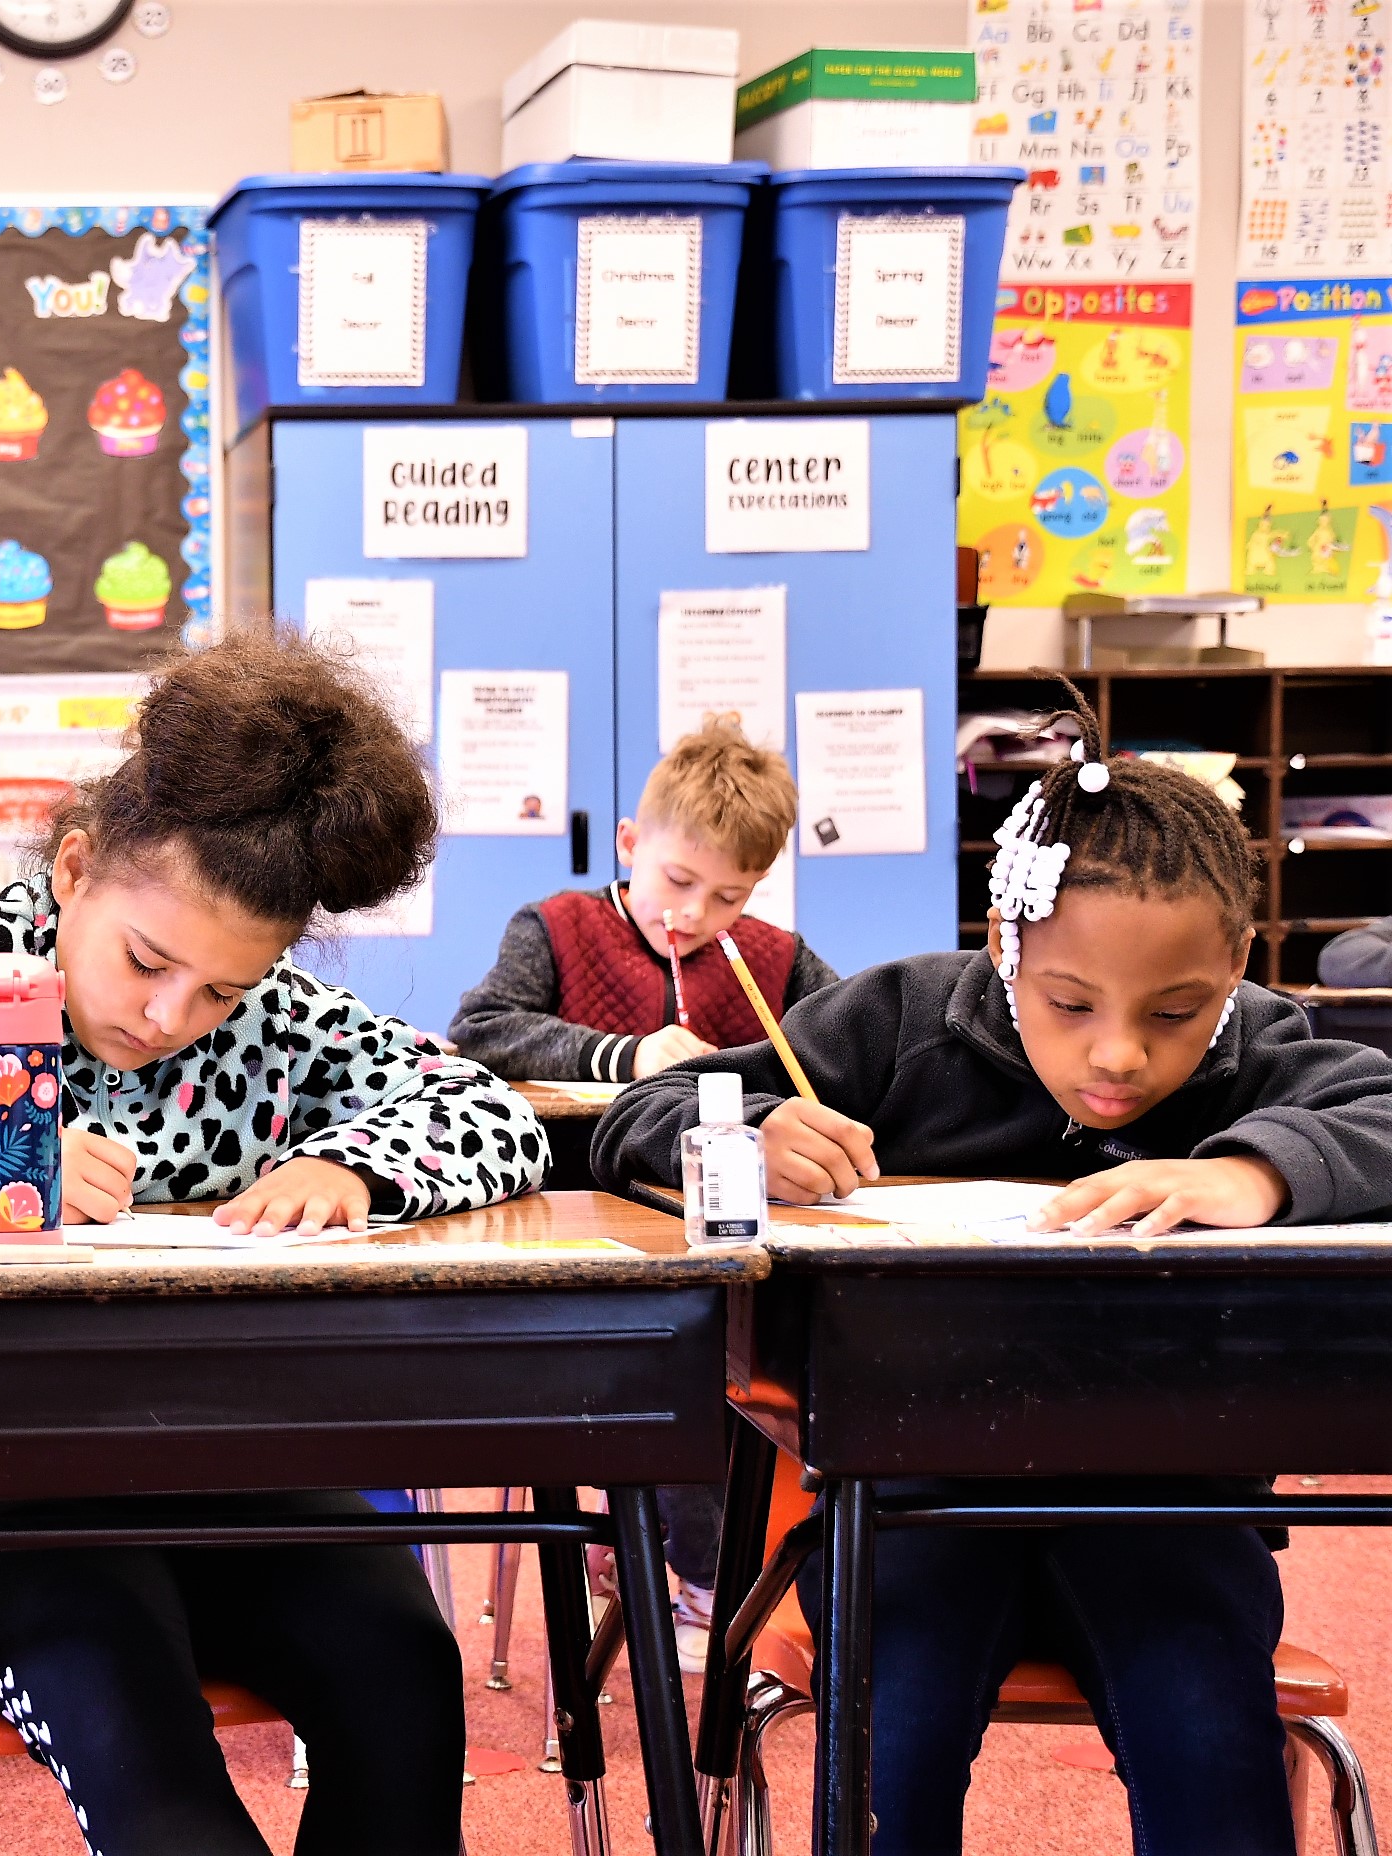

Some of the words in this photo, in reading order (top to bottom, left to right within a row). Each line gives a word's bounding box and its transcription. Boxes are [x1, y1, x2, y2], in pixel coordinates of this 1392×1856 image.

[600, 268, 675, 284] Christmas
[873, 268, 926, 285] Spring
[27, 273, 109, 315] You!
[1022, 284, 1170, 323] Opposites
[1278, 283, 1383, 313] Position
[391, 457, 497, 488] Guided
[383, 496, 510, 527] Reading
[1098, 1139, 1145, 1160] Columbi
